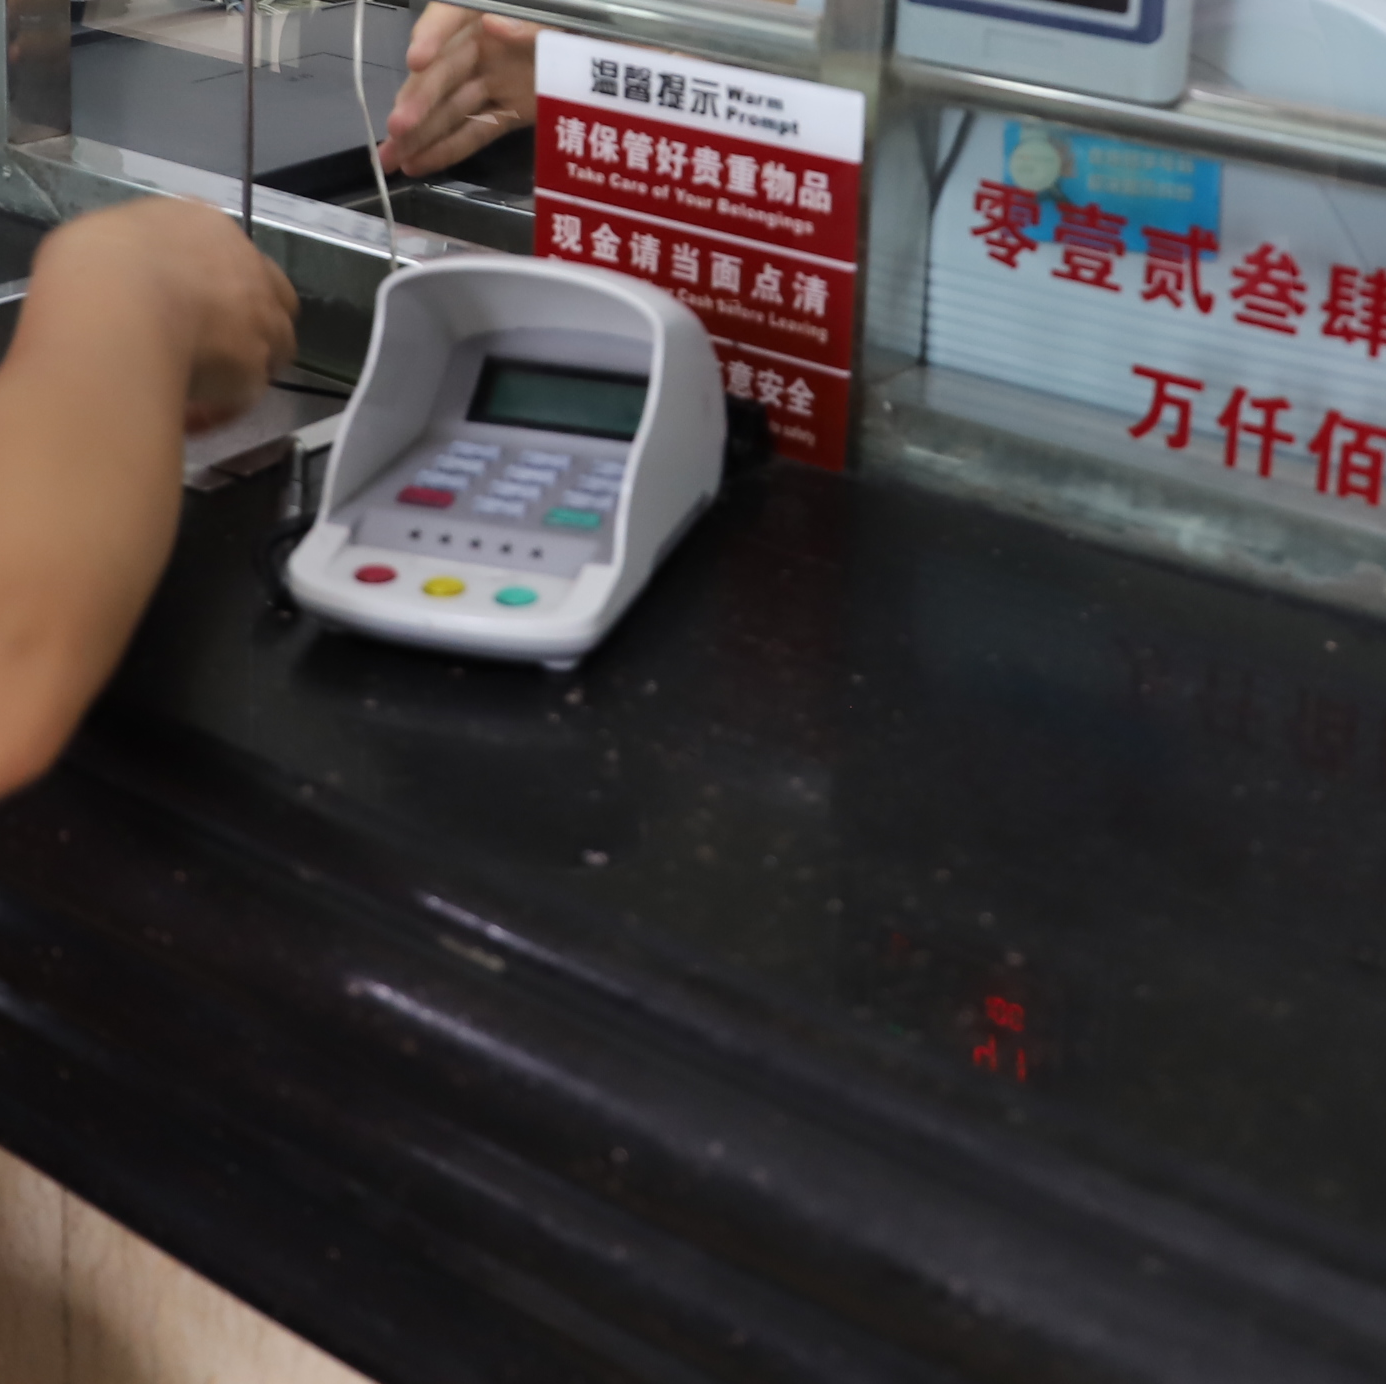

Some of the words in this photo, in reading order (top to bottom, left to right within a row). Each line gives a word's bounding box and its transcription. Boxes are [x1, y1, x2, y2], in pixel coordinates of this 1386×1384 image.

[591, 57, 721, 119] 温馨提示
[726, 83, 784, 111] Warm
[725, 106, 799, 136] Prompt
[554, 115, 833, 215] 请保管好贵重物品
[567, 161, 606, 186] Take
[609, 172, 649, 196] Care
[651, 184, 671, 200] of
[674, 186, 714, 210] Your
[716, 197, 815, 236] Belongings
[551, 213, 830, 317] 现金请当面点清
[718, 359, 815, 417] 意安全
